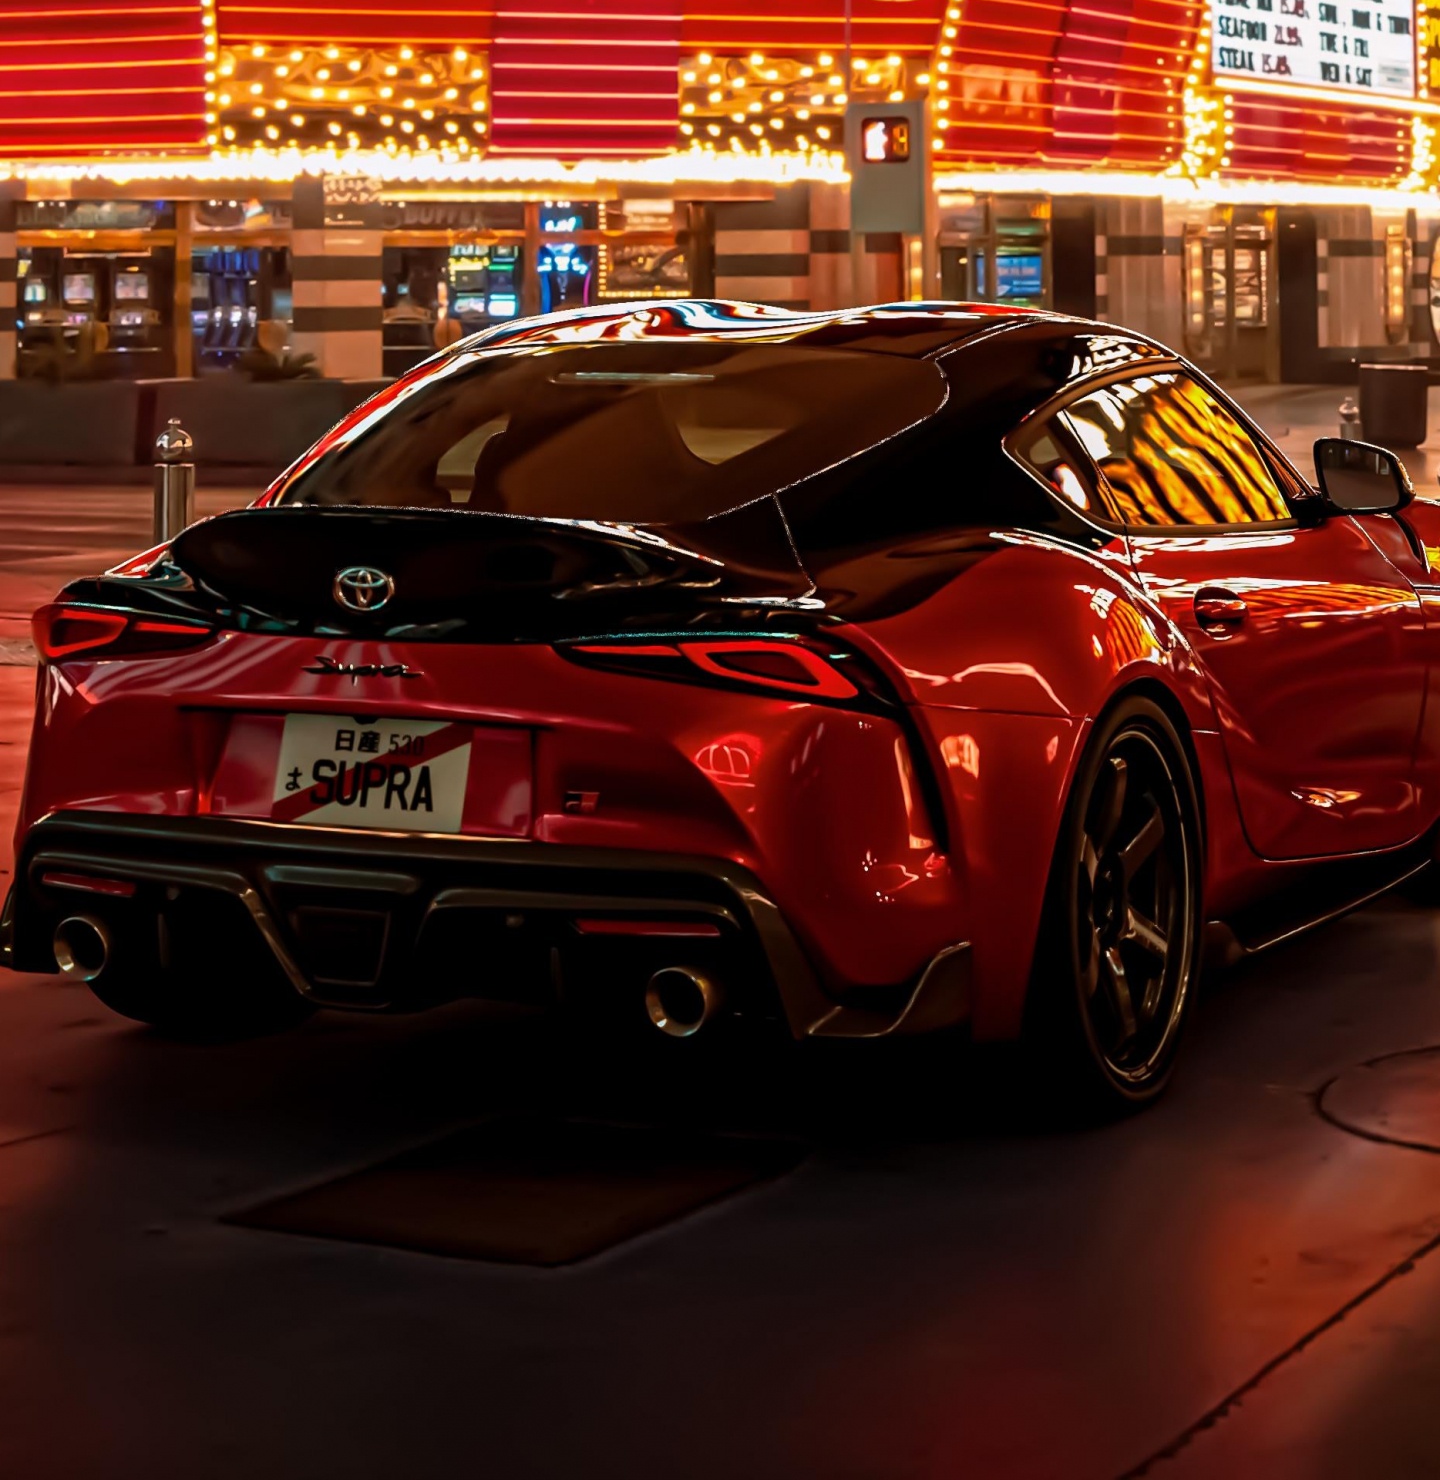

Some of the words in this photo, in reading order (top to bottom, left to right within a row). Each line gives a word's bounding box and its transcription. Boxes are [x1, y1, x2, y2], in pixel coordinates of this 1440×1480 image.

[301, 655, 425, 687] Supra
[334, 729, 380, 754] 日産
[309, 758, 434, 813] SUPRA
